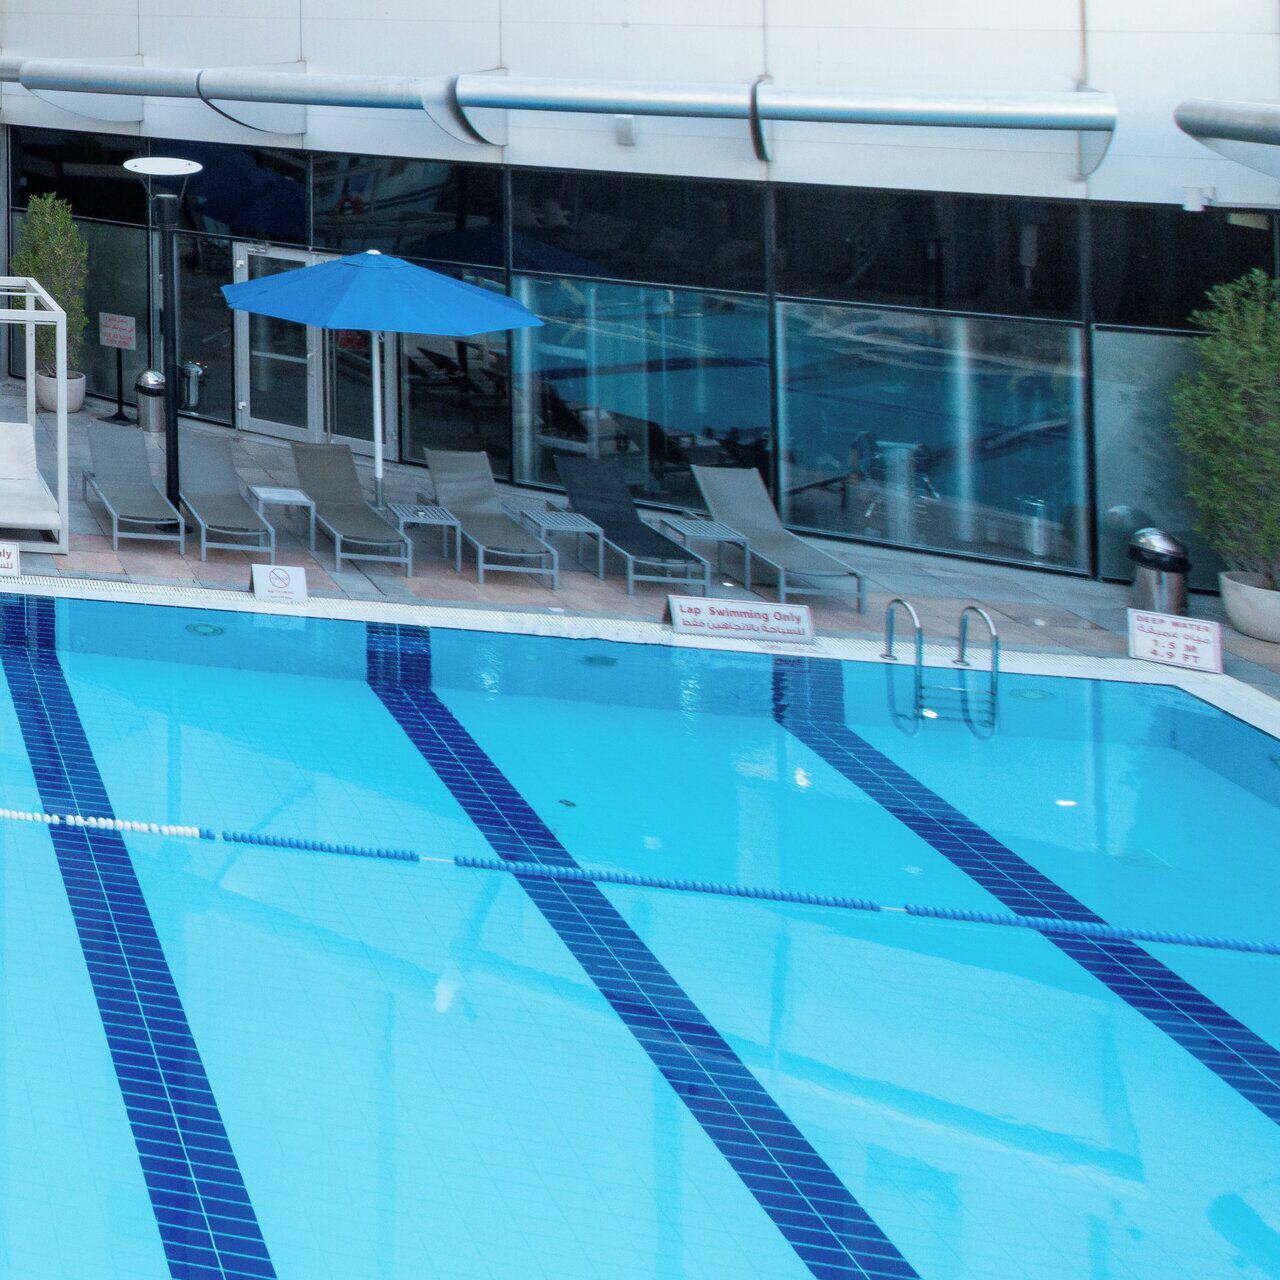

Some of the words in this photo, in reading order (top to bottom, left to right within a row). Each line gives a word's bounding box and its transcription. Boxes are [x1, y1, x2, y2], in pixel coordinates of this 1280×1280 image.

[680, 604, 701, 615] Lap
[708, 606, 769, 622] Swimming
[773, 611, 801, 624] Only
[1137, 615, 1165, 624] DEEP
[1171, 621, 1210, 632] WATER
[1184, 644, 1196, 652] M
[1183, 654, 1200, 662] FT
